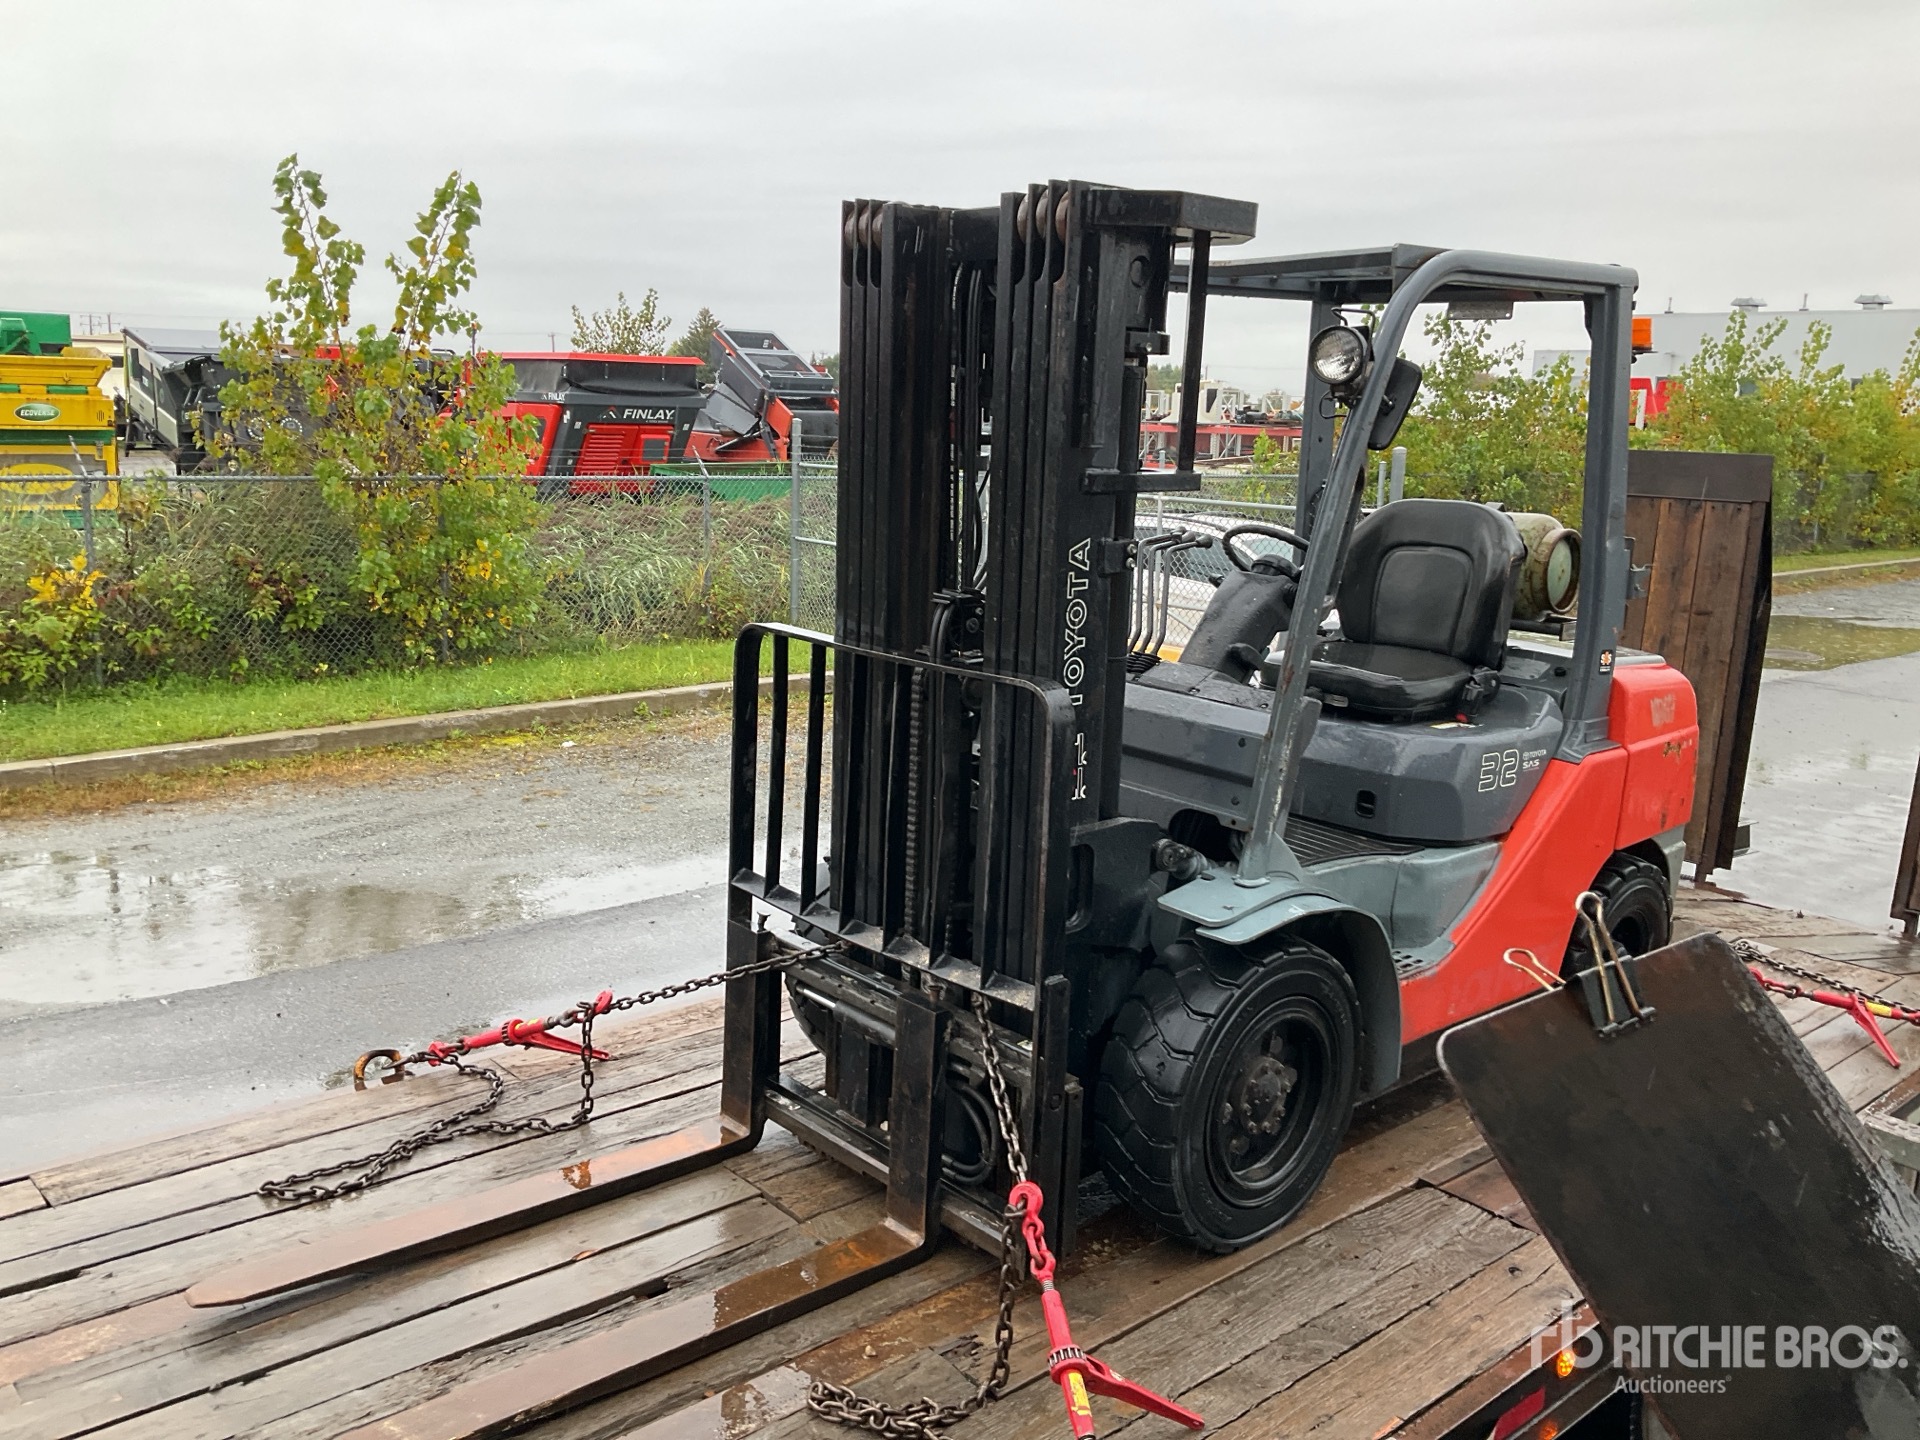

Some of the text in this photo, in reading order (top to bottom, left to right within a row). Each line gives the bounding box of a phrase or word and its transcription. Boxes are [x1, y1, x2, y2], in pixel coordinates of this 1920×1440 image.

[623, 408, 675, 420] FINLAY
[1522, 759, 1540, 769] SAS
[1478, 749, 1520, 792] 32
